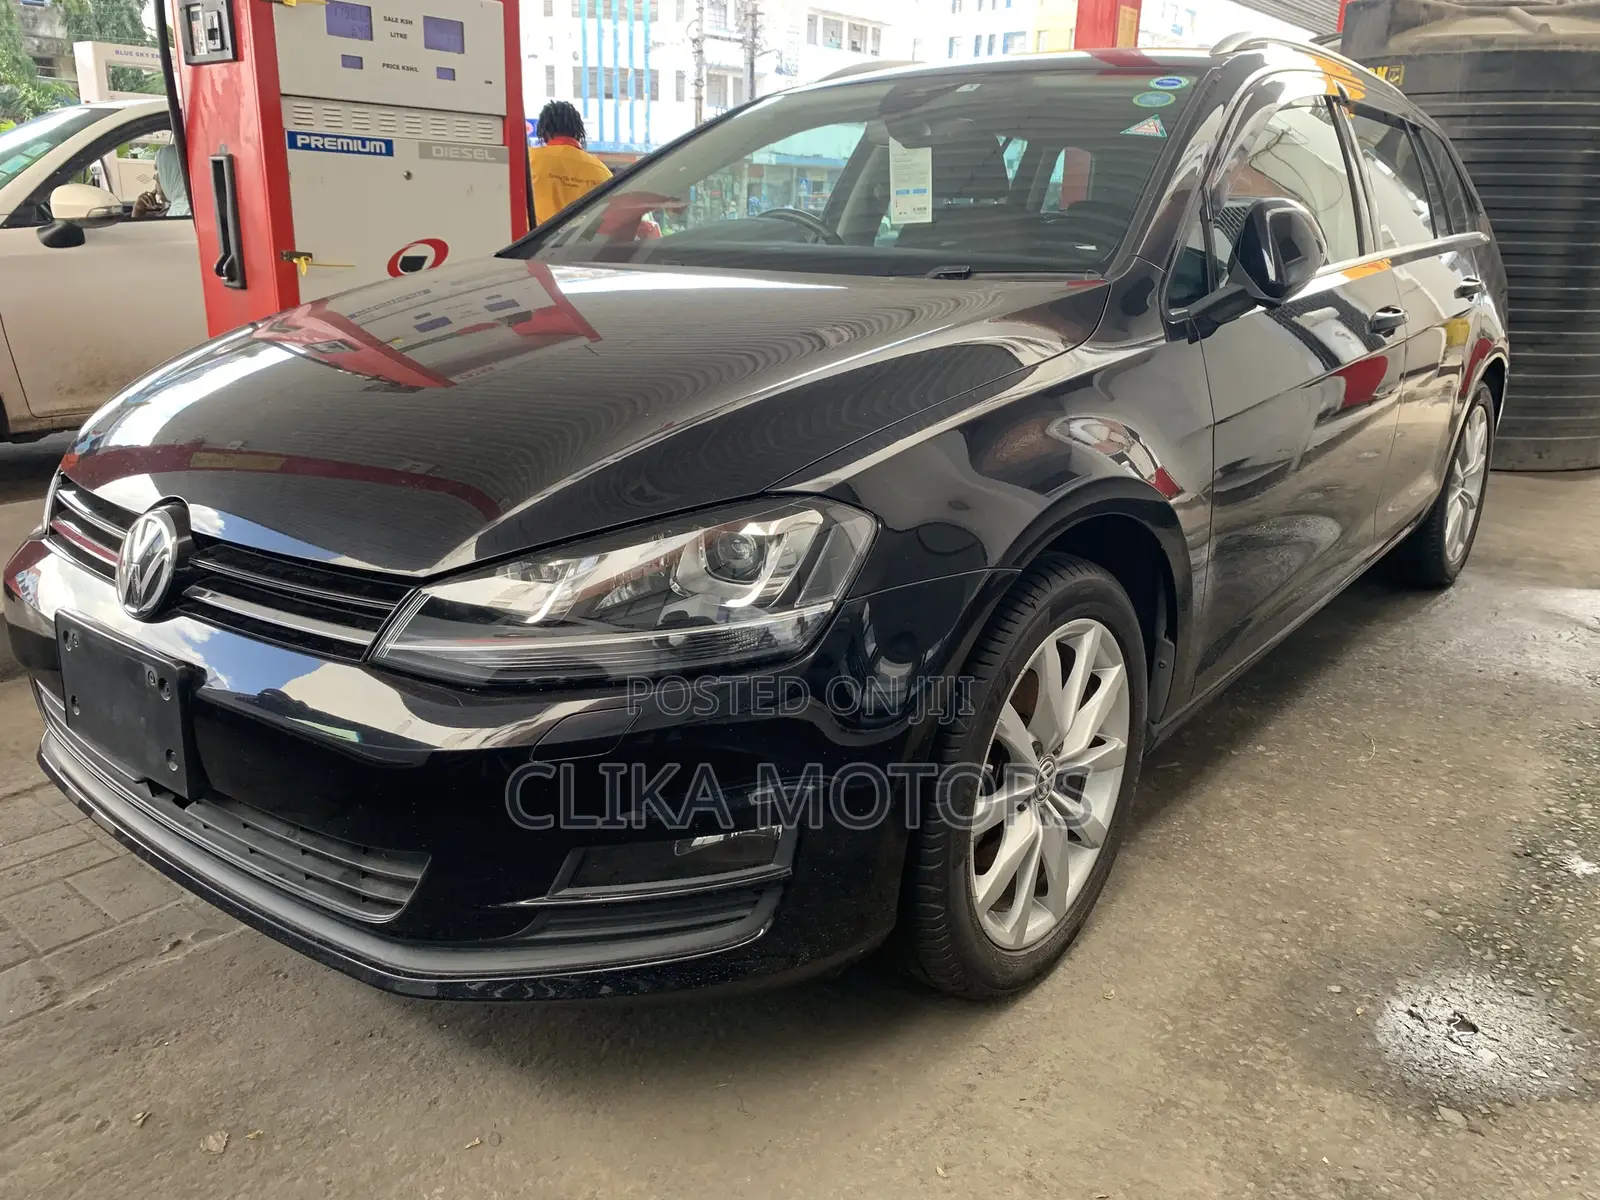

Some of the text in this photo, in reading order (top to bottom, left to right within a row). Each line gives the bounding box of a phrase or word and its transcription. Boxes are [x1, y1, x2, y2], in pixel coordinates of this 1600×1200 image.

[383, 15, 399, 24] SALE
[389, 31, 407, 39] LITRE
[115, 49, 133, 57] BLUE
[382, 62, 400, 71] PRICE
[296, 134, 386, 154] PREMIUM
[432, 145, 496, 161] DIESEL
